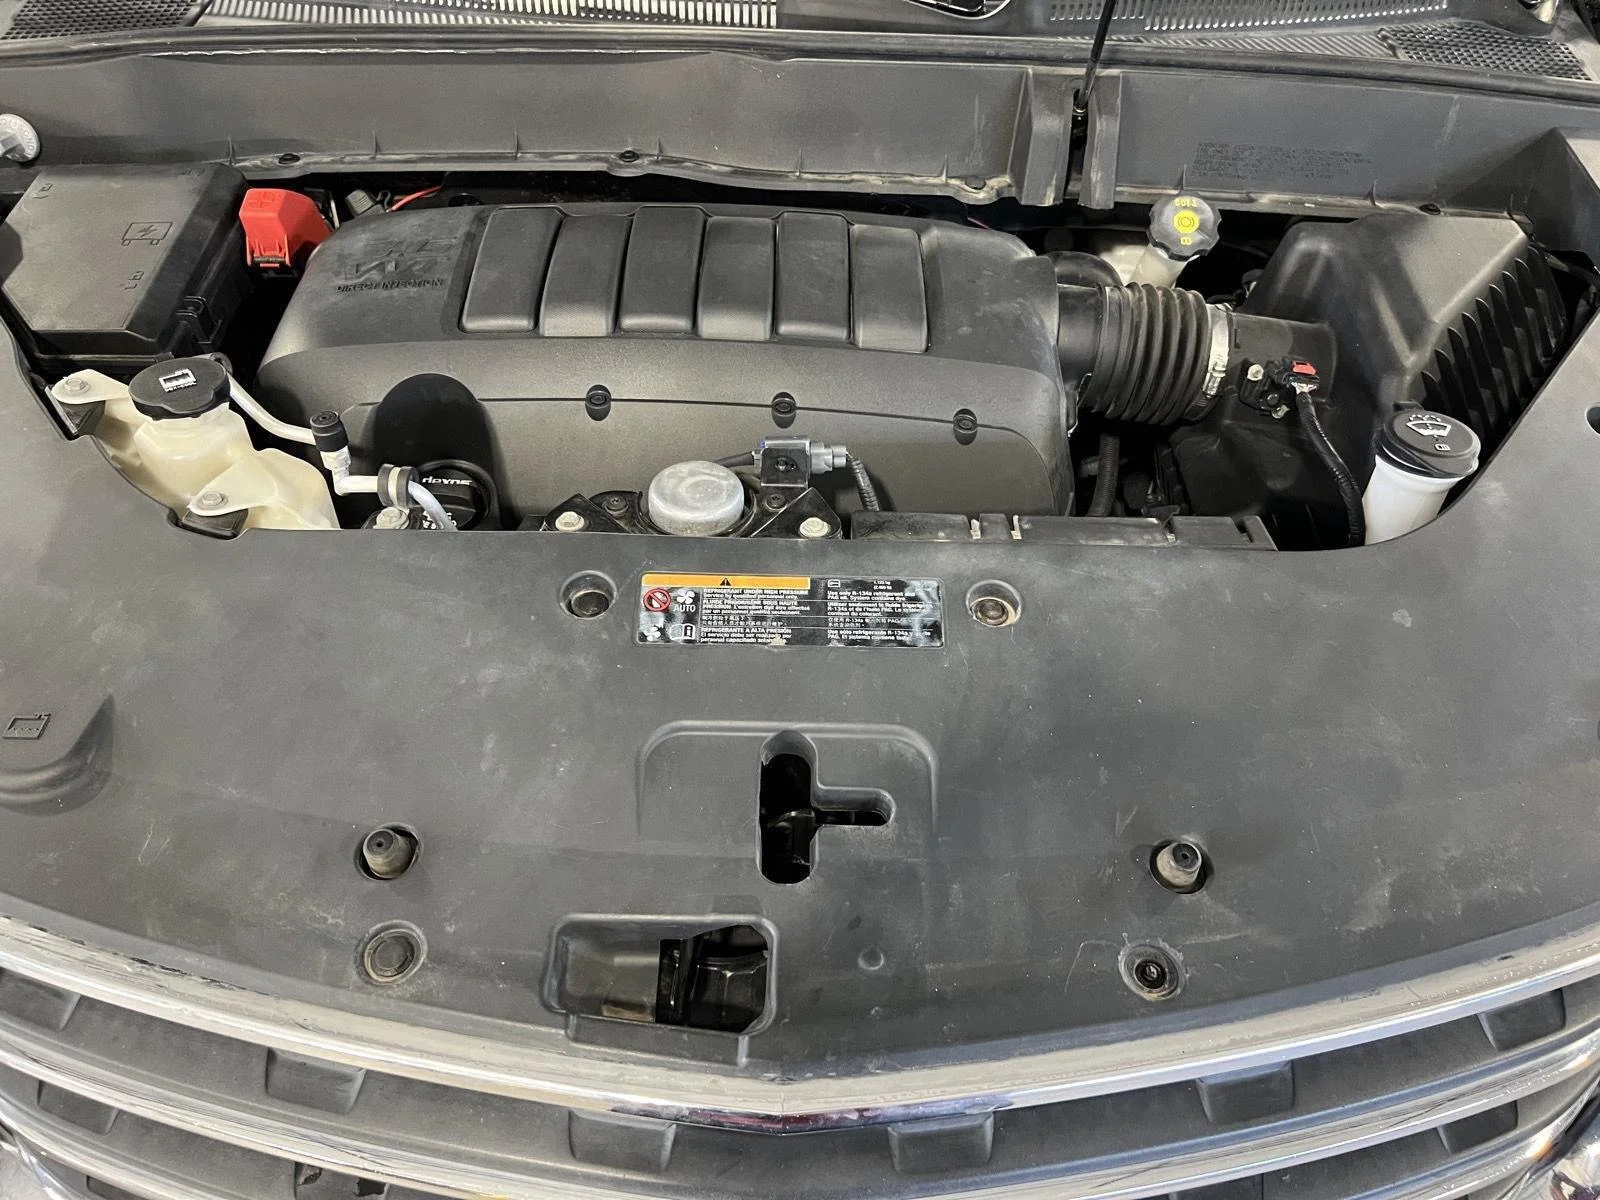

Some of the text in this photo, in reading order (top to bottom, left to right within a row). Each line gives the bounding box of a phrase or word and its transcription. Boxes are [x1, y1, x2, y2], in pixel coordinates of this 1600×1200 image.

[1174, 198, 1197, 208] DOT 3
[336, 278, 443, 293] DIRECT INJECTION
